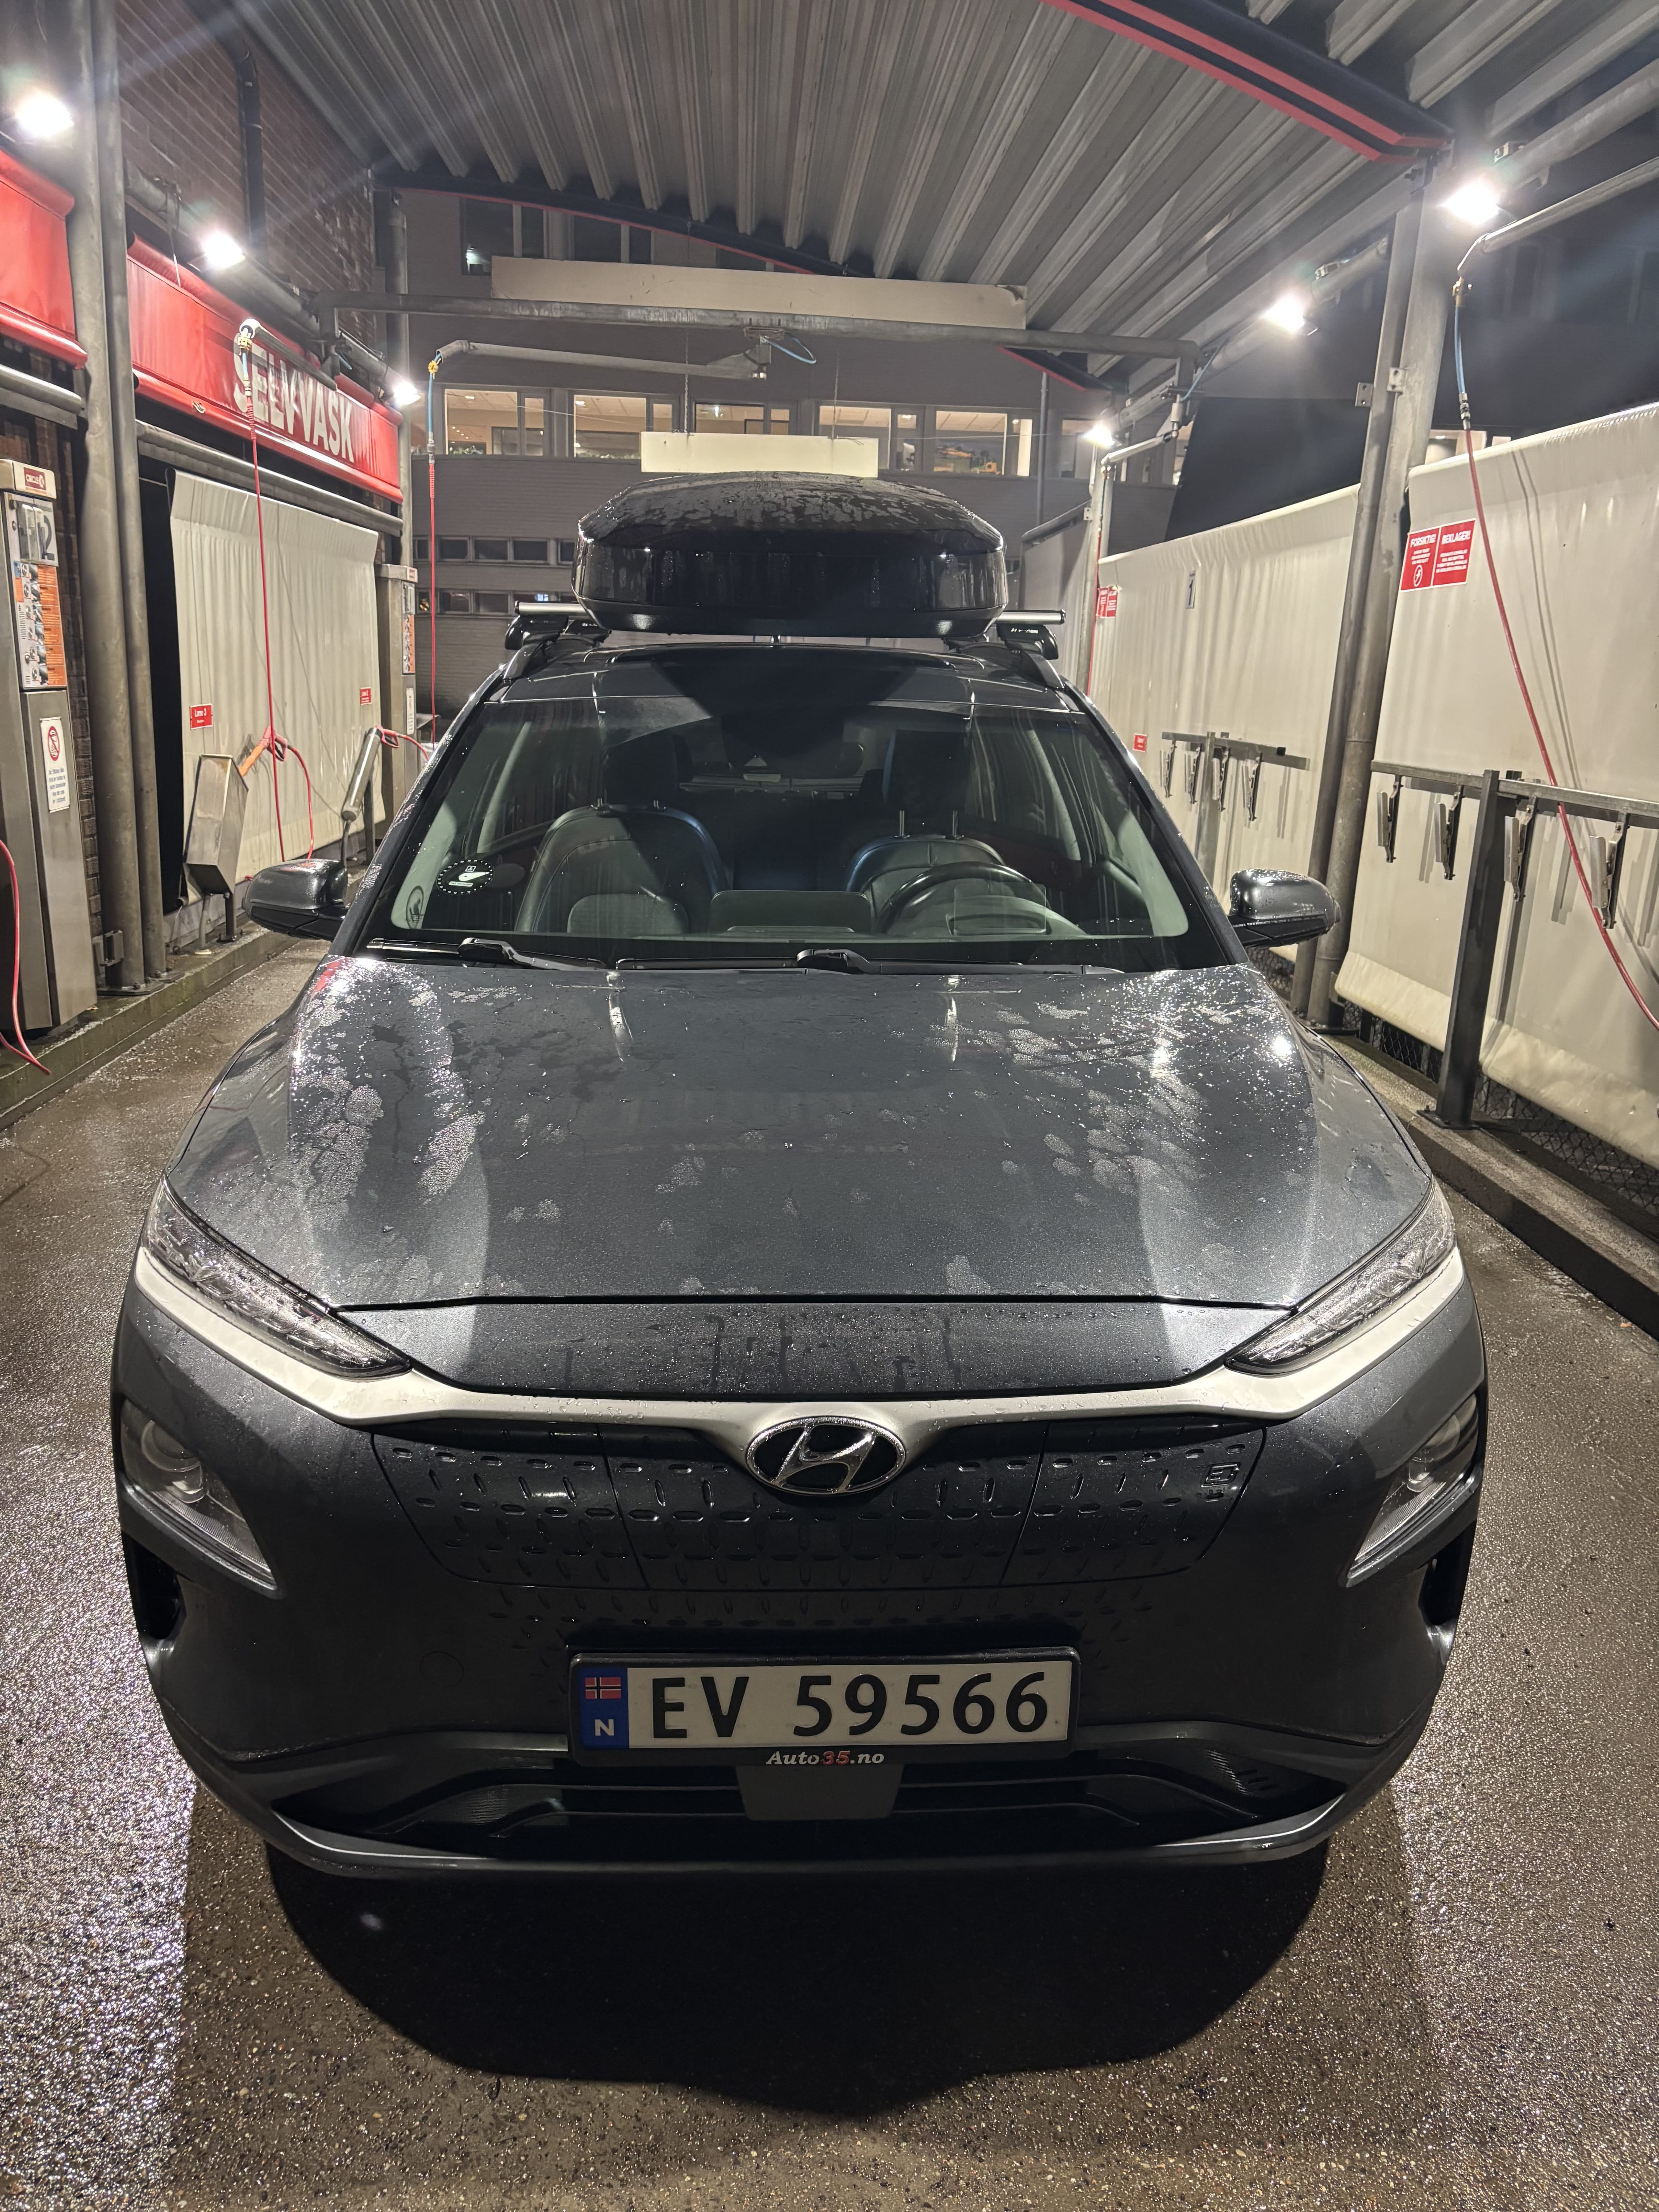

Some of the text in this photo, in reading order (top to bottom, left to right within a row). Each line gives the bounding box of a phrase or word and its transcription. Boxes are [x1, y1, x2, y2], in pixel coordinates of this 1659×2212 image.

[652, 1671, 1048, 1739] EV 59566
[595, 1719, 615, 1736] N
[766, 1750, 885, 1765] Auto35.no
